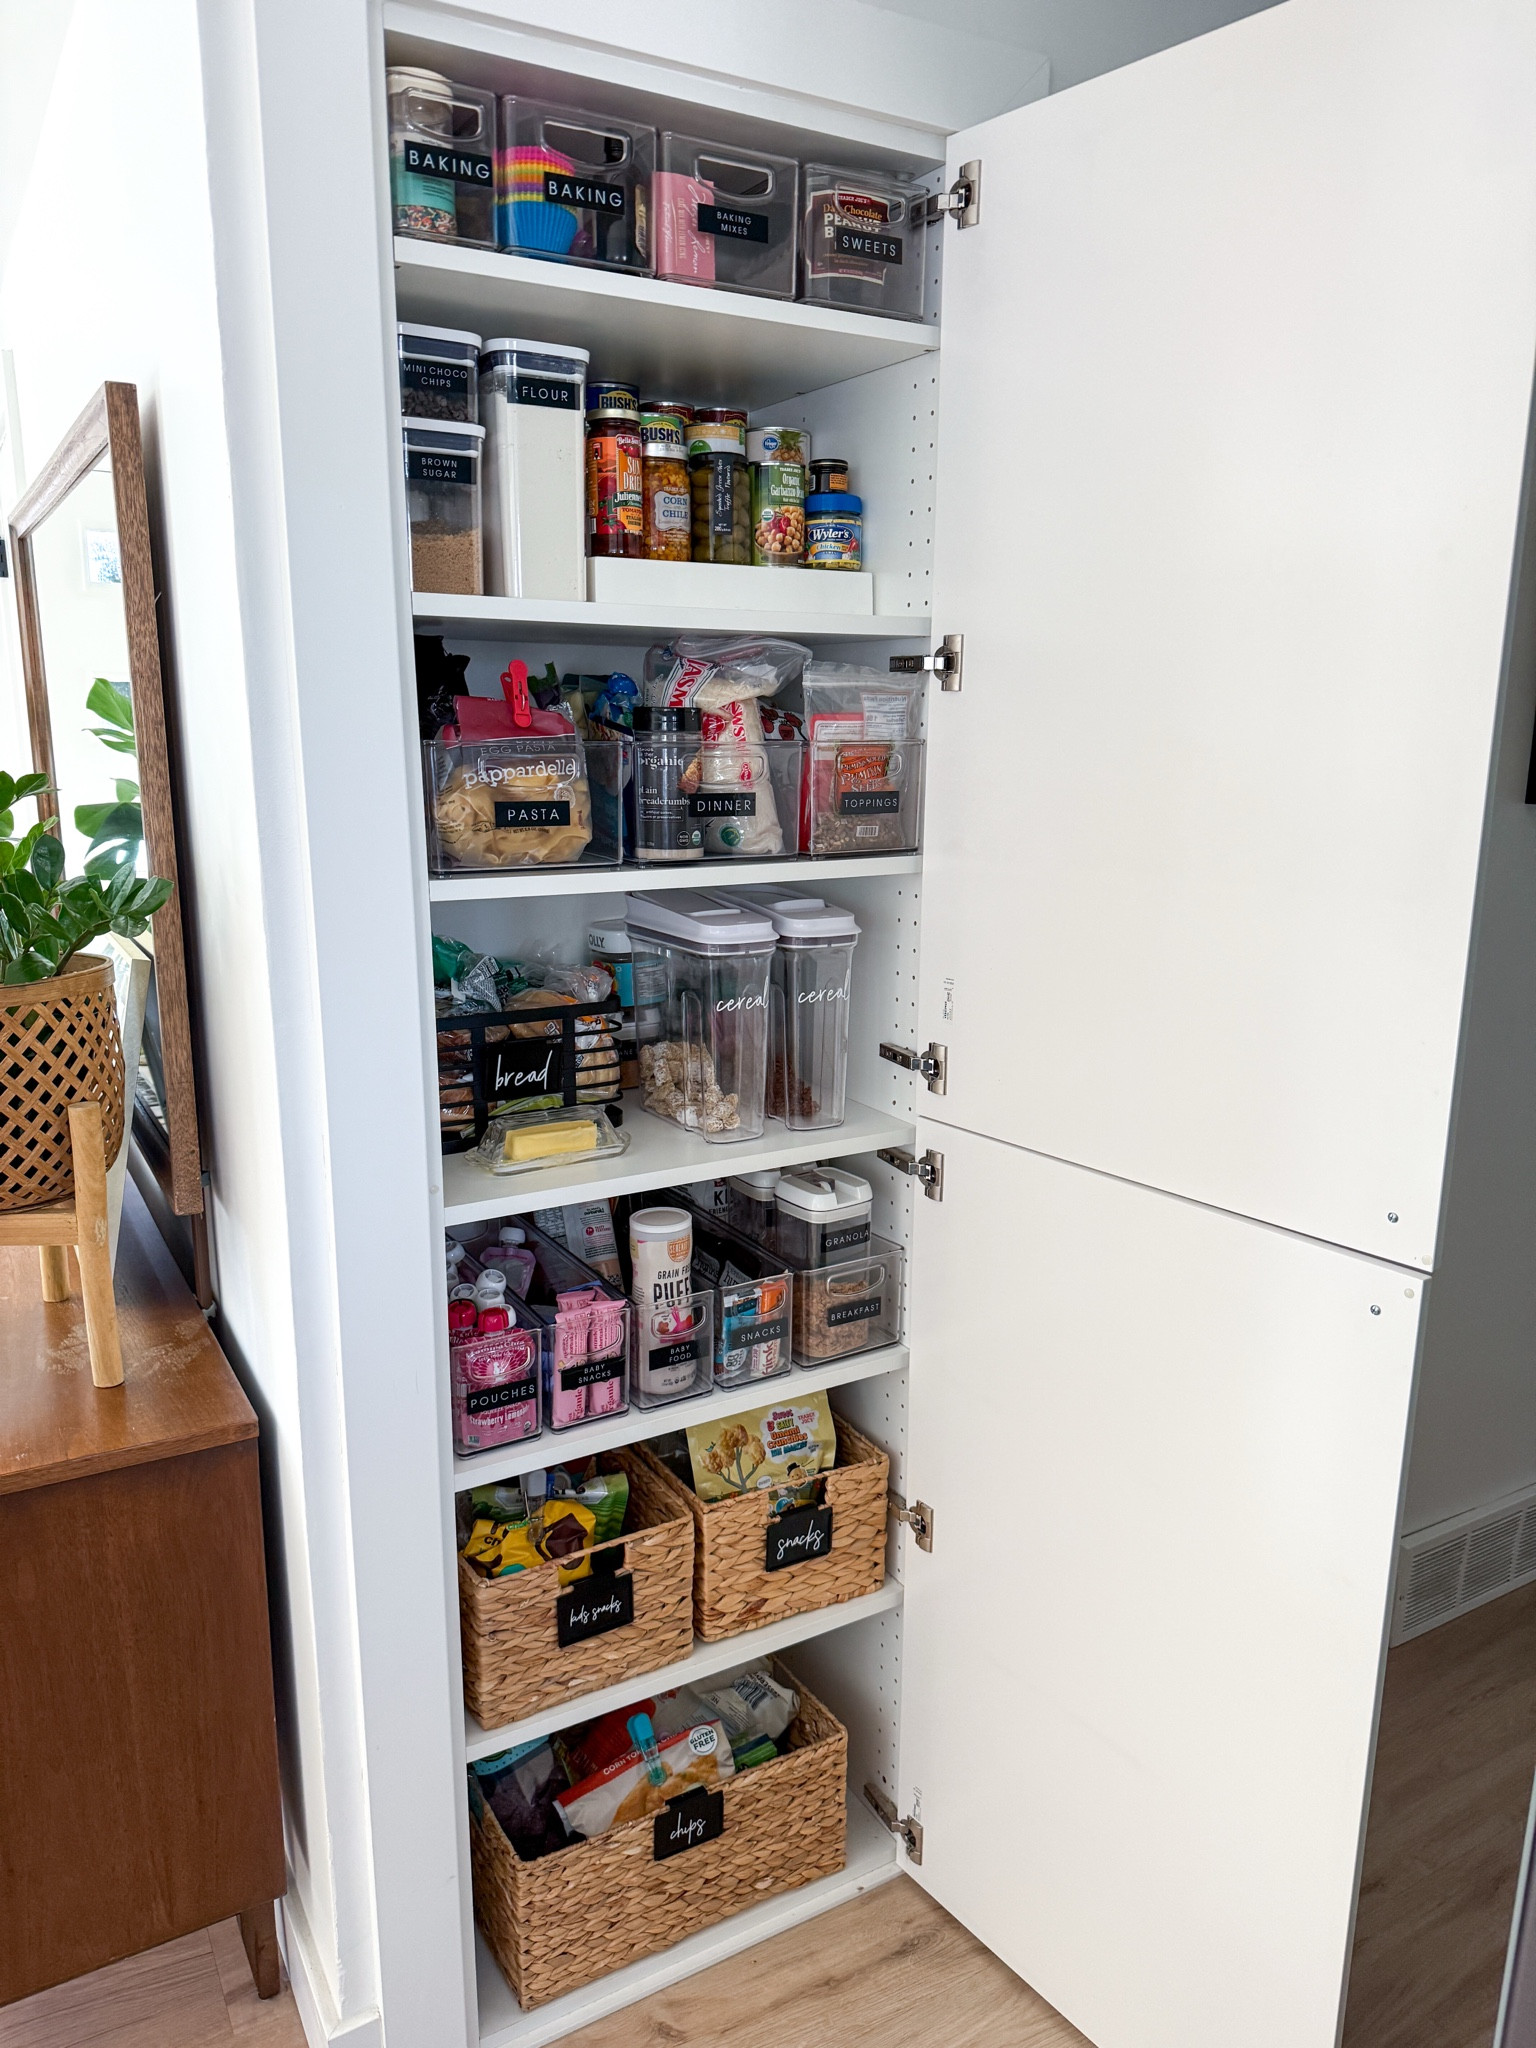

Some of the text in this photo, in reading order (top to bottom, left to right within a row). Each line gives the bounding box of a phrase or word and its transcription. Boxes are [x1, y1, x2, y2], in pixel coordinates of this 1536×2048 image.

[409, 149, 490, 179] BAKING
[548, 180, 622, 207] BAKING
[716, 211, 752, 226] BAKING
[843, 204, 883, 221] Chocolate
[720, 223, 748, 236] MIXES
[842, 235, 896, 257] SWEETS
[403, 363, 468, 379] MINI CHOCO
[421, 376, 451, 388] CHIPS
[522, 386, 569, 402] FLOUR
[601, 396, 638, 410] BUSH'S
[640, 427, 680, 445] BUSH'S
[421, 457, 458, 468] BROWN
[627, 456, 641, 475] SUN
[422, 468, 457, 479] SUGAR
[623, 471, 642, 491] DRIE
[770, 484, 796, 498] Garbanzo
[663, 496, 688, 506] CORN
[662, 509, 689, 519] CHILE
[810, 528, 850, 541] Wyler's
[816, 542, 841, 550] Chicken
[480, 742, 556, 756] EGG PASTA
[461, 758, 576, 790] pappardelle
[697, 799, 752, 812] DINNER
[844, 798, 898, 808] TOPPINGS
[507, 808, 560, 821] PASTA
[588, 933, 605, 949] OLLY
[716, 975, 770, 1012] cereal
[797, 968, 851, 1004] cereal
[495, 1049, 554, 1091] bread
[825, 1229, 871, 1248] GRANOLA
[657, 1267, 680, 1280] GRAIN
[830, 1302, 880, 1321] BREAKFAST
[741, 1325, 782, 1343] SNACKS
[670, 1344, 690, 1355] BABY
[669, 1352, 692, 1364] FOOD
[584, 1363, 606, 1374] BABY
[578, 1370, 612, 1384] SNACKS
[470, 1384, 536, 1409] POUCHES
[469, 1414, 504, 1427] Strawberry
[797, 1412, 815, 1420] TRADER
[767, 1432, 809, 1449] Crunchies
[770, 1426, 801, 1440] Umami
[776, 1519, 826, 1560] snacks
[569, 1594, 623, 1629] kids snacks
[689, 1728, 715, 1746] GLUTEN
[692, 1735, 716, 1751] FREE
[602, 1757, 627, 1776] CORN
[669, 1811, 707, 1844] chips
